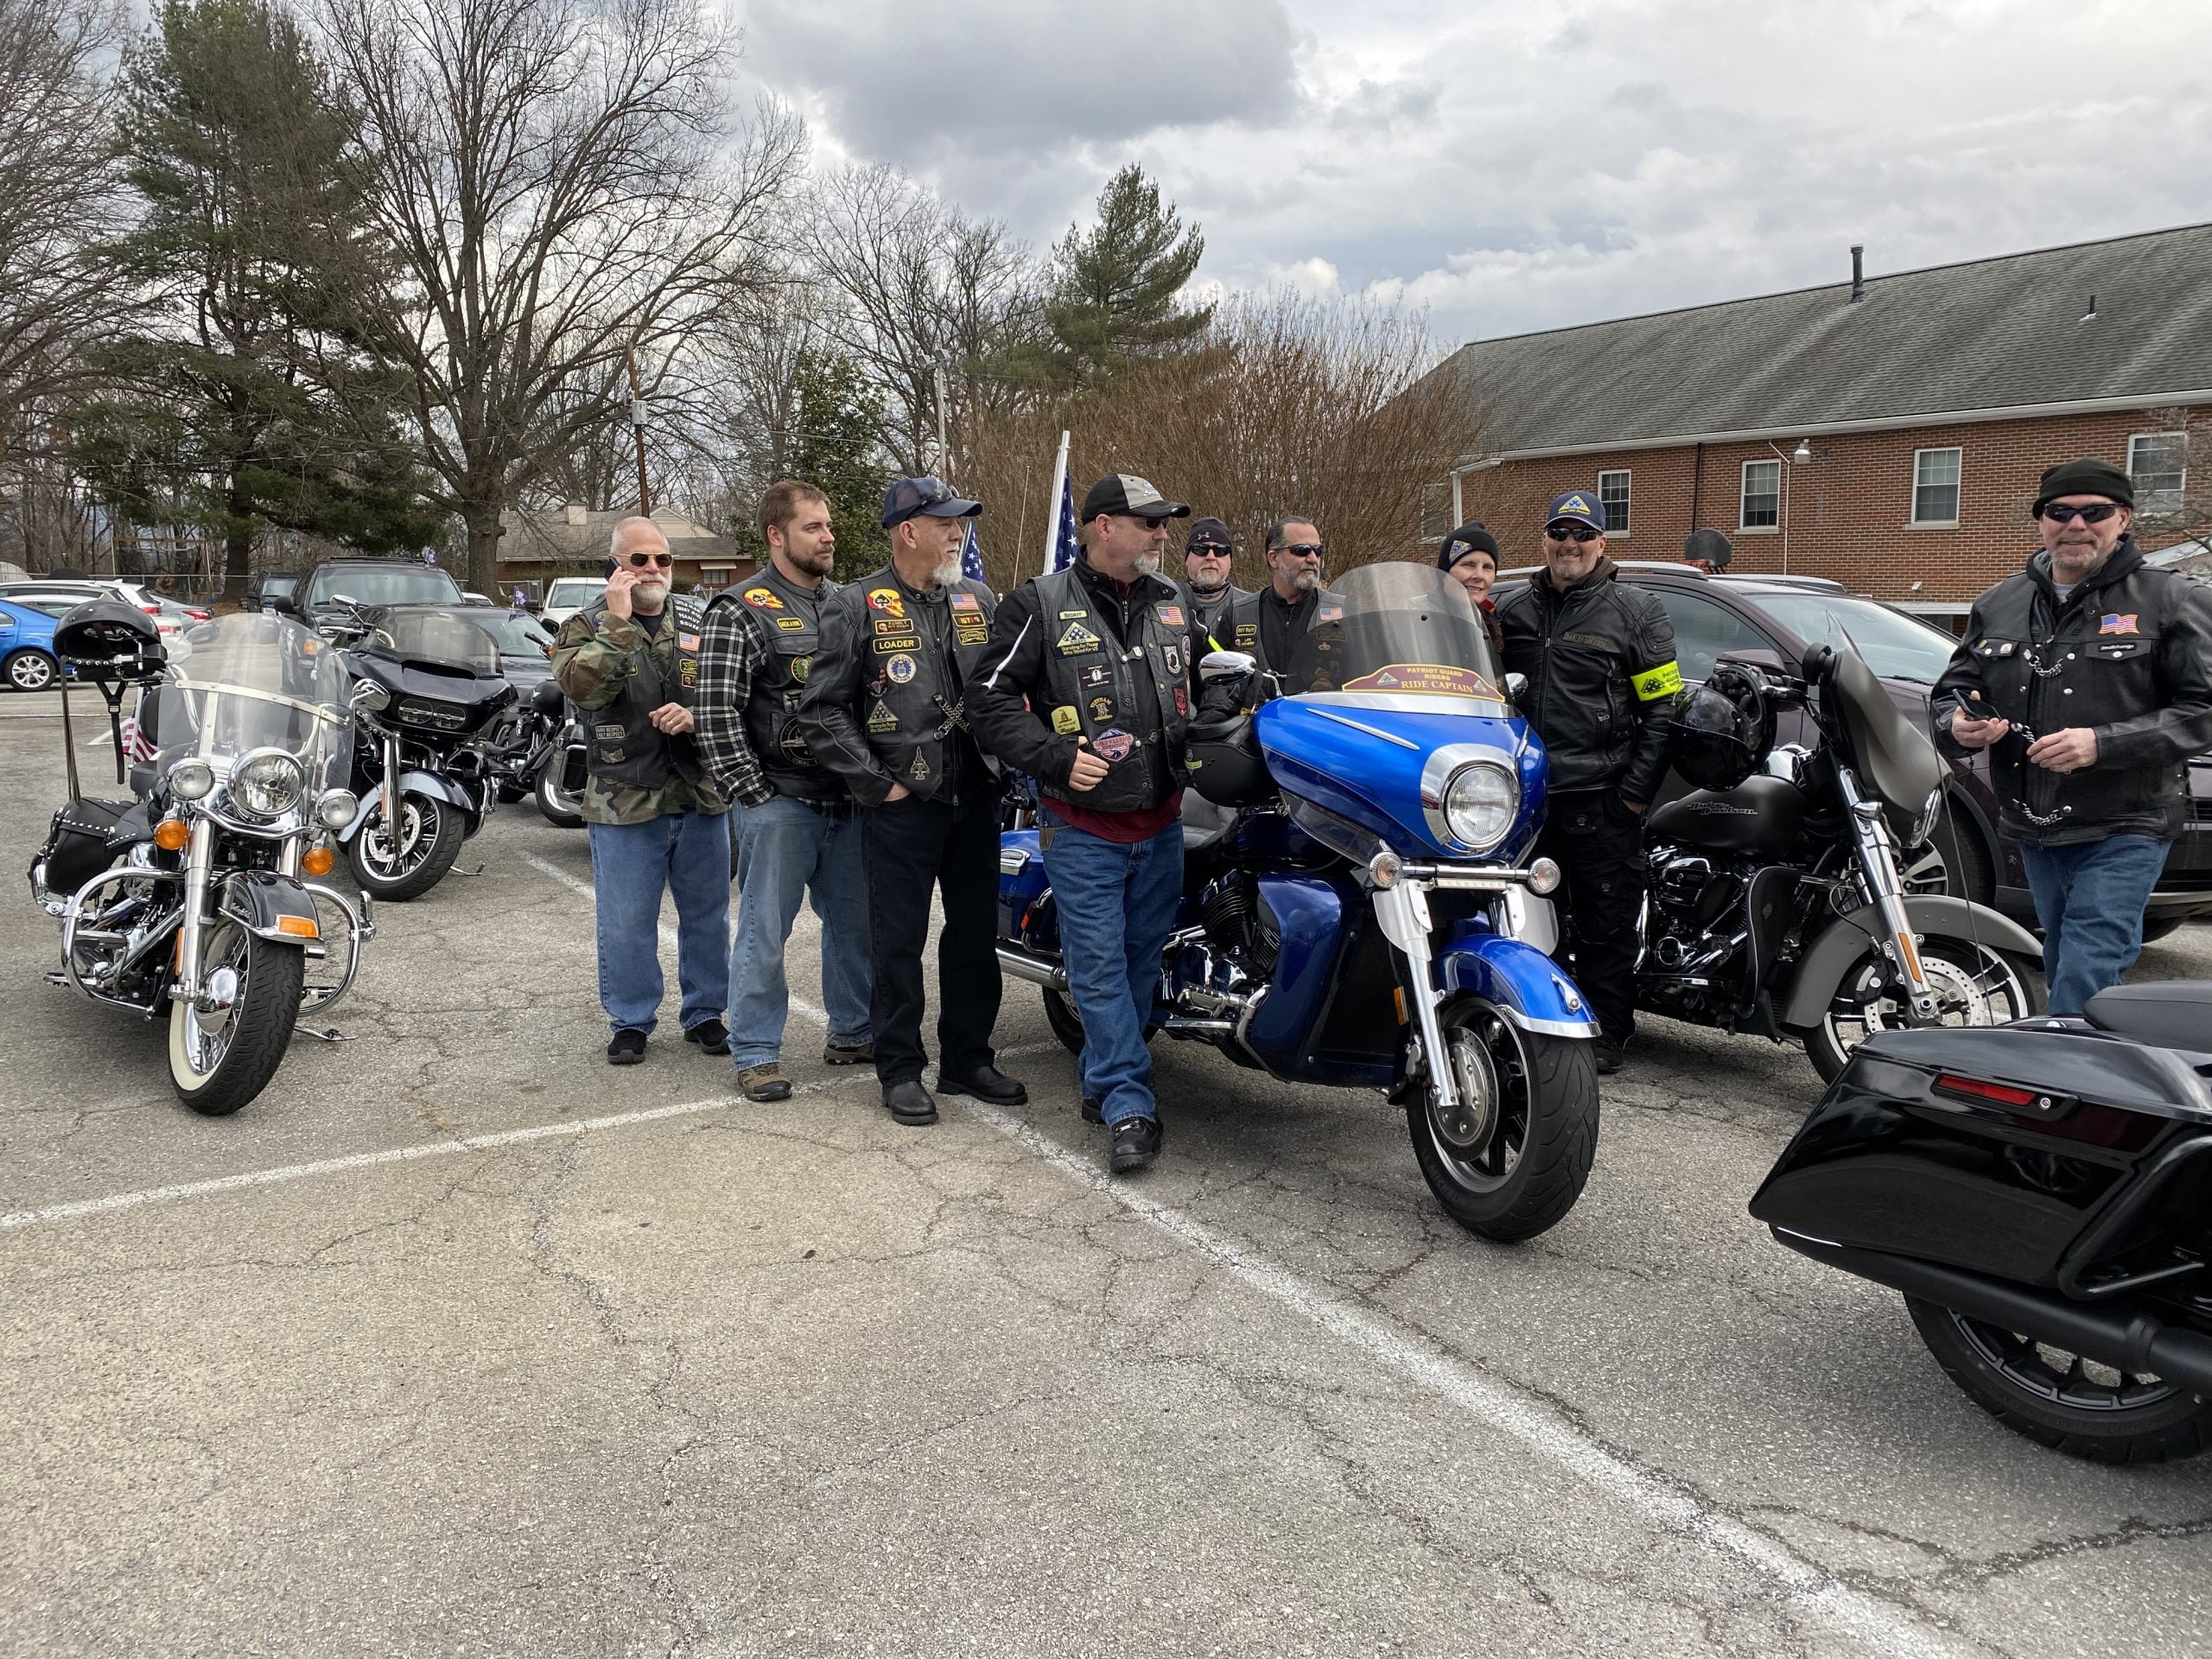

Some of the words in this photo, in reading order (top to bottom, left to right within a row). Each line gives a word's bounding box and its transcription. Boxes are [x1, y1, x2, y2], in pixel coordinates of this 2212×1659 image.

[879, 640, 914, 650] LOADER
[1440, 669, 1463, 677] GUARD
[1401, 680, 1428, 689] RIDE
[1431, 680, 1473, 693] CAPTAIN
[1090, 696, 1113, 709] VIETNAM
